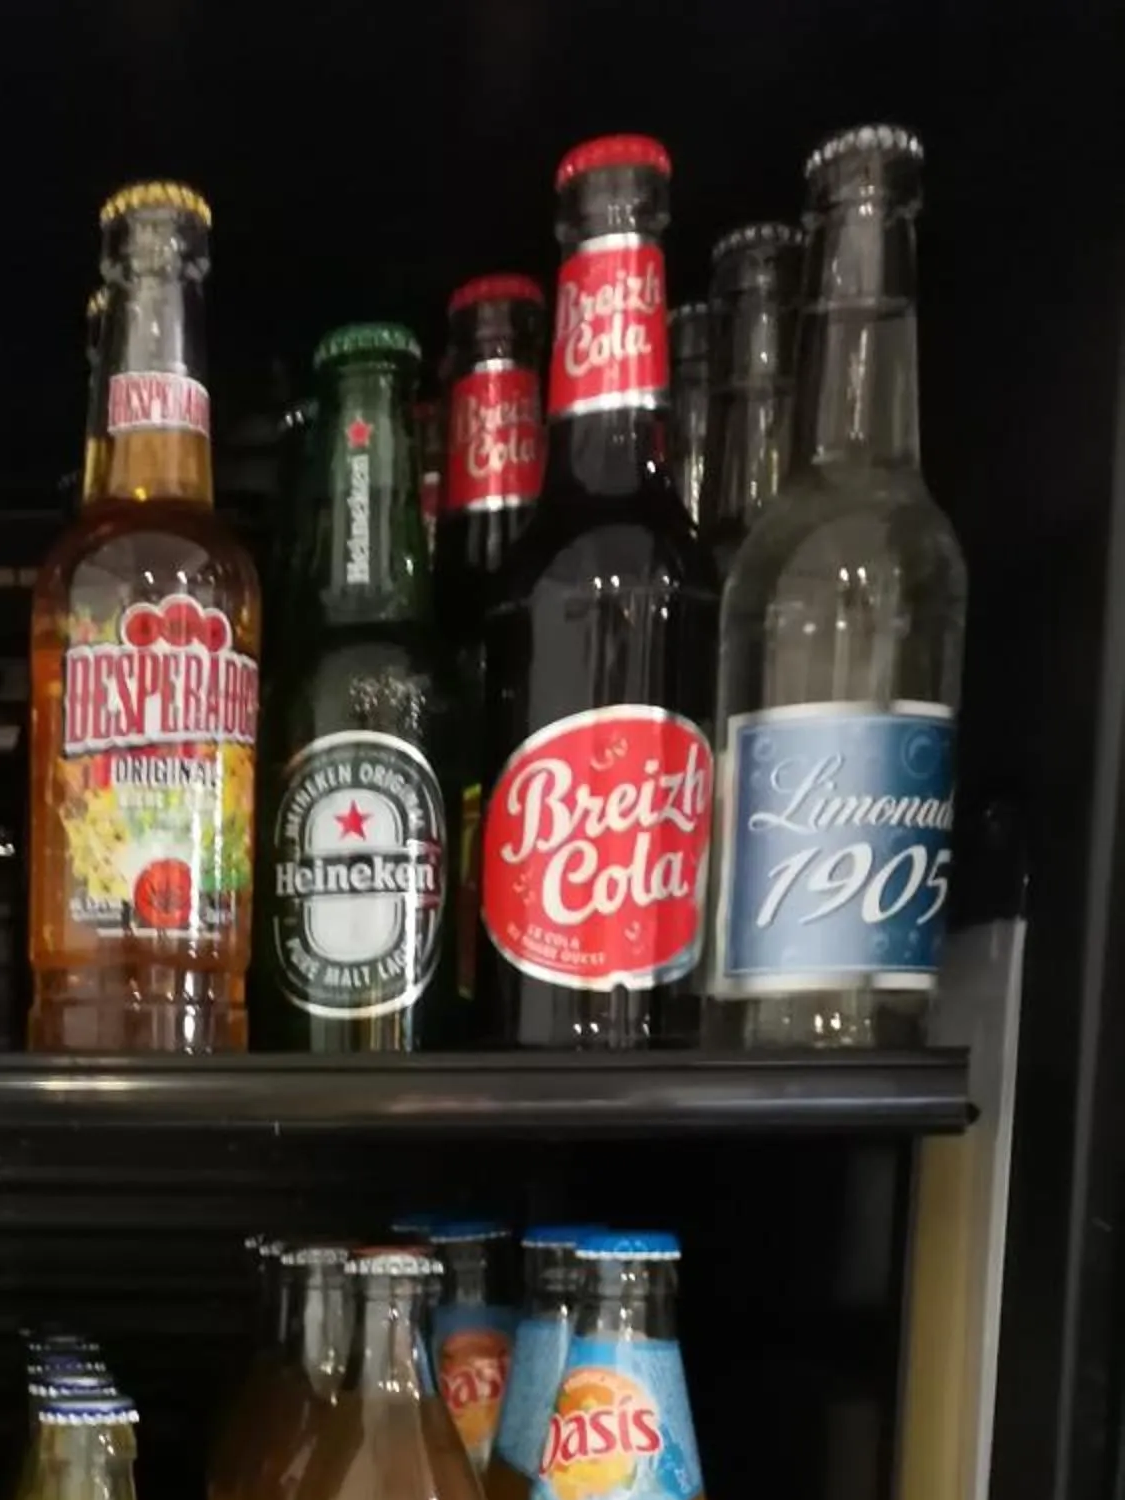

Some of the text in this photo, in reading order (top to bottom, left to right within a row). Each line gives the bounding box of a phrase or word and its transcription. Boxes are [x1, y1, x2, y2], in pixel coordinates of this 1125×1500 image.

[564, 312, 652, 378] Cola
[500, 742, 707, 864] Breizh
[275, 855, 435, 897] Heineken
[542, 832, 688, 926] Cola
[756, 841, 952, 929] 1905
